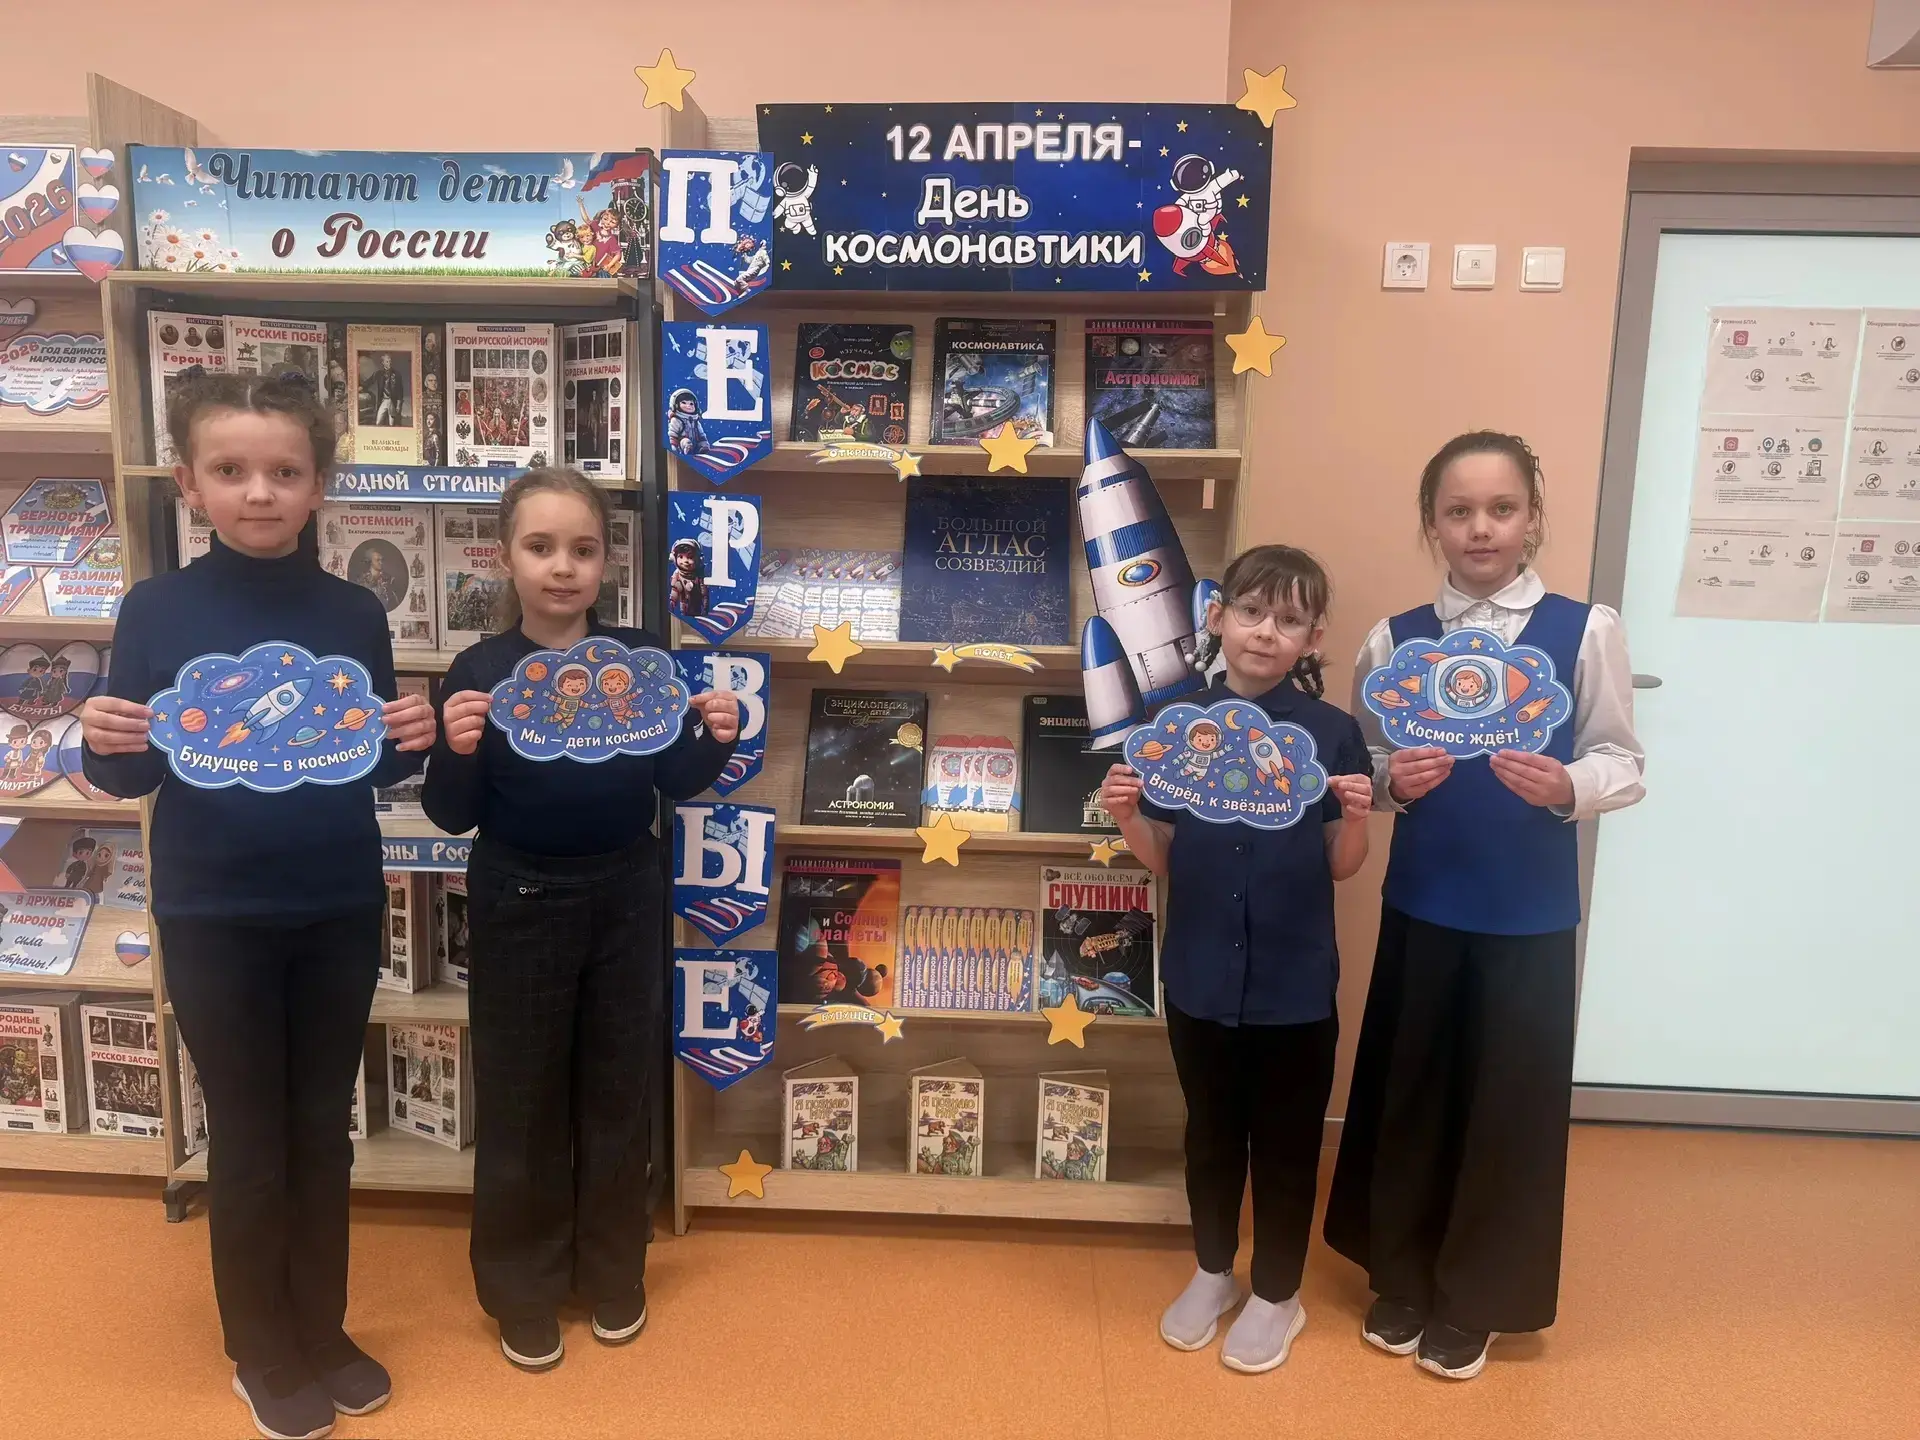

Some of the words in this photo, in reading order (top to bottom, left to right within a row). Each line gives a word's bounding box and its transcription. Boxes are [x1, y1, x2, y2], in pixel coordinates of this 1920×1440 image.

[886, 124, 932, 161] 12
[943, 123, 1142, 162] АПРЕЛЯ-
[208, 152, 419, 202] Читают
[438, 159, 551, 203] дети
[917, 178, 1029, 226] День
[0, 178, 73, 242] 026
[271, 227, 296, 258] о
[317, 211, 490, 259] России
[235, 327, 288, 340] РУССКИЕ
[454, 336, 478, 346] ГЕРОИ
[479, 335, 513, 346] РУССКОЙ
[514, 336, 548, 346] ИСТОРИИ
[0, 341, 40, 364] 2026
[41, 347, 61, 355] ГОД
[952, 341, 1045, 351] КОСМОНАВТИКА
[29, 356, 77, 364] НАРОДОВ
[162, 352, 203, 364] Герои
[565, 367, 587, 377] ОРДЕНА
[594, 364, 621, 375] НАГРАДЫ
[810, 359, 899, 381] КОСМОС
[1104, 370, 1199, 387] Астрономия
[828, 448, 894, 459] ОТКРЫТИЕ
[19, 510, 96, 523] ВЕРНОСТЬ
[340, 515, 415, 528] ПОТЕМКИН
[937, 516, 1047, 534] БОЛЬШОЙ
[189, 536, 210, 544] ГОС
[935, 532, 1047, 558] АТЛАС
[935, 556, 1047, 575] СОЗВЕЗДИЙ
[7, 703, 63, 715] БУРЯТЫ
[831, 699, 909, 710] ЭНЦИКЛОПЕДИЯ
[519, 727, 546, 746] Мы
[566, 735, 601, 749] дети
[605, 719, 669, 746] космоса!
[1405, 719, 1465, 744] Космос
[1470, 728, 1521, 747] ждёт!
[179, 745, 259, 774] Будущее
[283, 759, 293, 771] в
[298, 739, 373, 771] космосе!
[1149, 772, 1205, 807] Вперёд,
[1209, 796, 1218, 807] к
[1223, 798, 1293, 816] звёздам!
[828, 800, 895, 811] АСТРОНОМИЯ
[122, 849, 144, 860] НАРО
[446, 873, 466, 886] КОС
[1084, 874, 1105, 882] ОБО
[16, 895, 24, 905] В
[26, 895, 75, 909] ДРУЖБЕ
[1048, 883, 1149, 912] СПУТНИКИ
[9, 913, 66, 928] НАРОДОВ
[834, 911, 889, 928] Солнце
[14, 934, 43, 948] сила
[91, 1051, 126, 1063] РУССКОЕ
